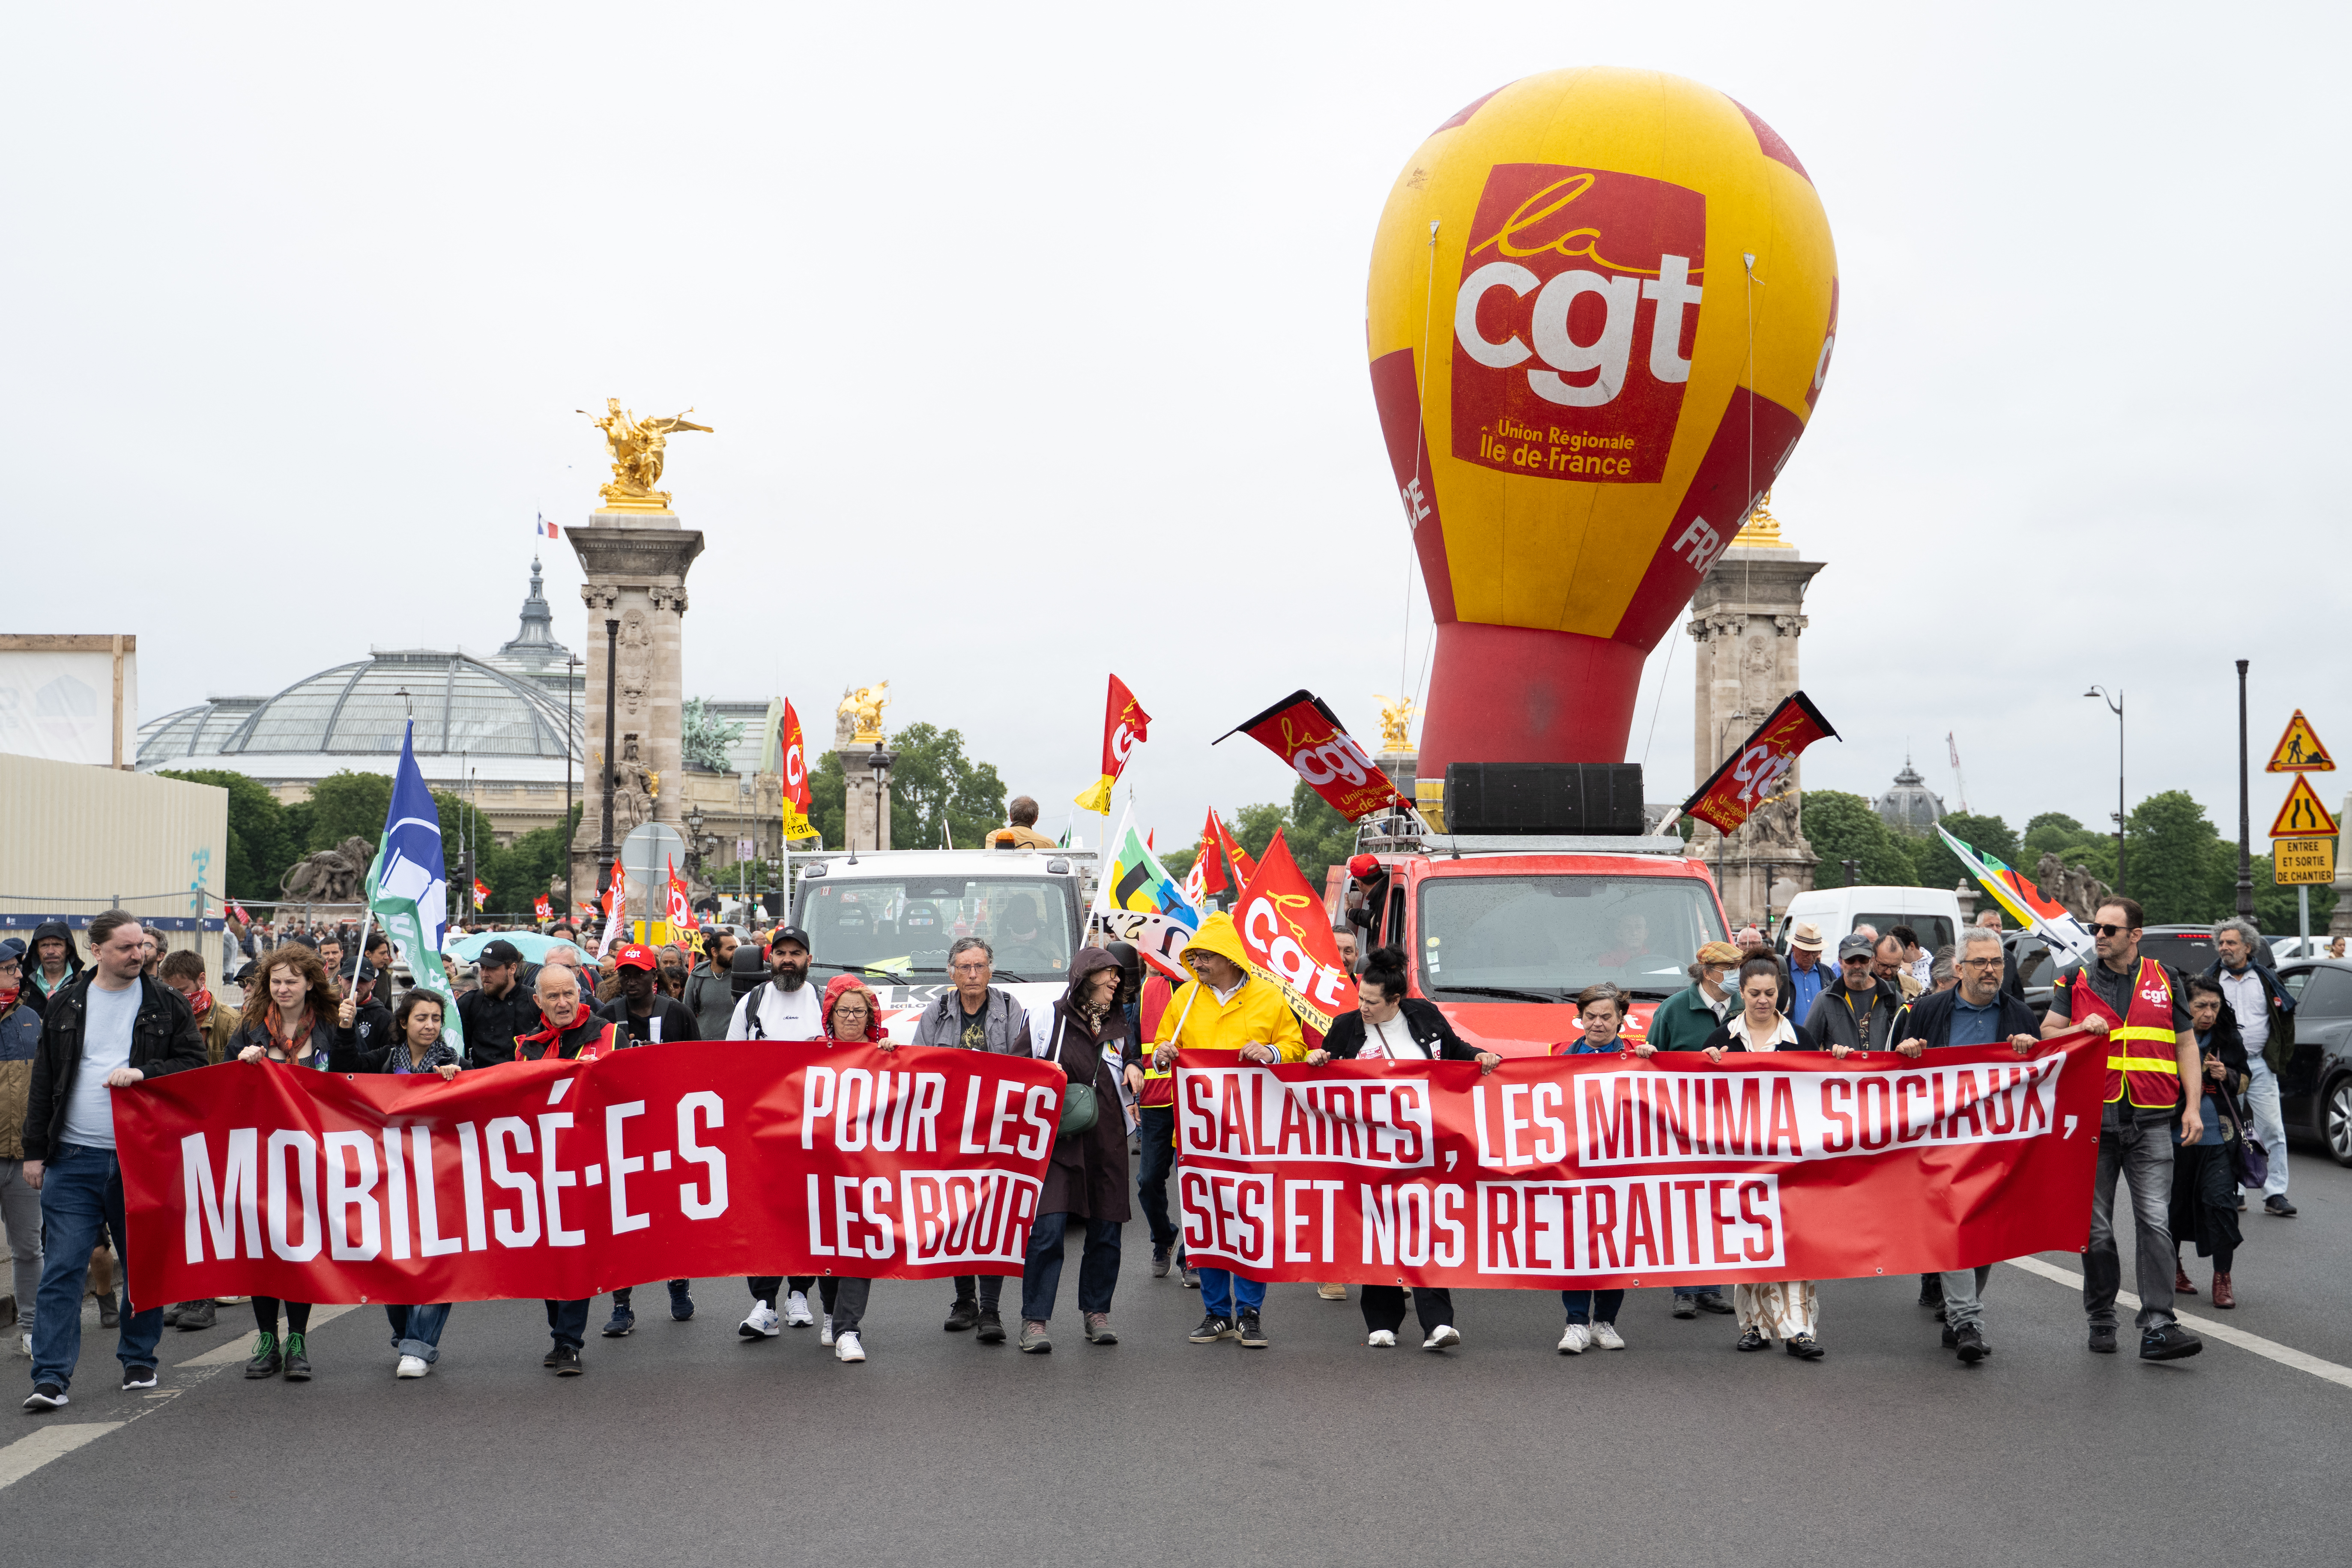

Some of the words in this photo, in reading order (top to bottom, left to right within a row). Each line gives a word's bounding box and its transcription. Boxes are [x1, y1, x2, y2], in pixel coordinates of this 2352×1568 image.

[1454, 254, 1702, 407] cgt
[1480, 426, 1507, 462] Île
[1498, 419, 1542, 442] Union
[1548, 426, 1635, 452] Régionale
[1671, 515, 1726, 579] FRA
[1293, 728, 1376, 786] cgt
[2283, 857, 2293, 866] ET
[2295, 856, 2325, 866] SORTIE
[2287, 841, 2319, 852] ENTREE
[2277, 872, 2288, 881] DE
[2291, 870, 2331, 881] CHANTIER
[625, 950, 641, 959] cgt
[1244, 896, 1345, 1007] cgt
[2141, 989, 2167, 1003] cgt
[801, 1065, 946, 1153] POUR
[959, 1075, 1058, 1161] LES
[1473, 1081, 1566, 1168] LES
[1584, 1076, 1802, 1161] MINIMA
[807, 1173, 895, 1260] LES
[1181, 1171, 1264, 1262] SES
[1285, 1179, 1343, 1263] ET
[1362, 1183, 1465, 1268] NOS
[1487, 1180, 1775, 1269] RETRAITES
